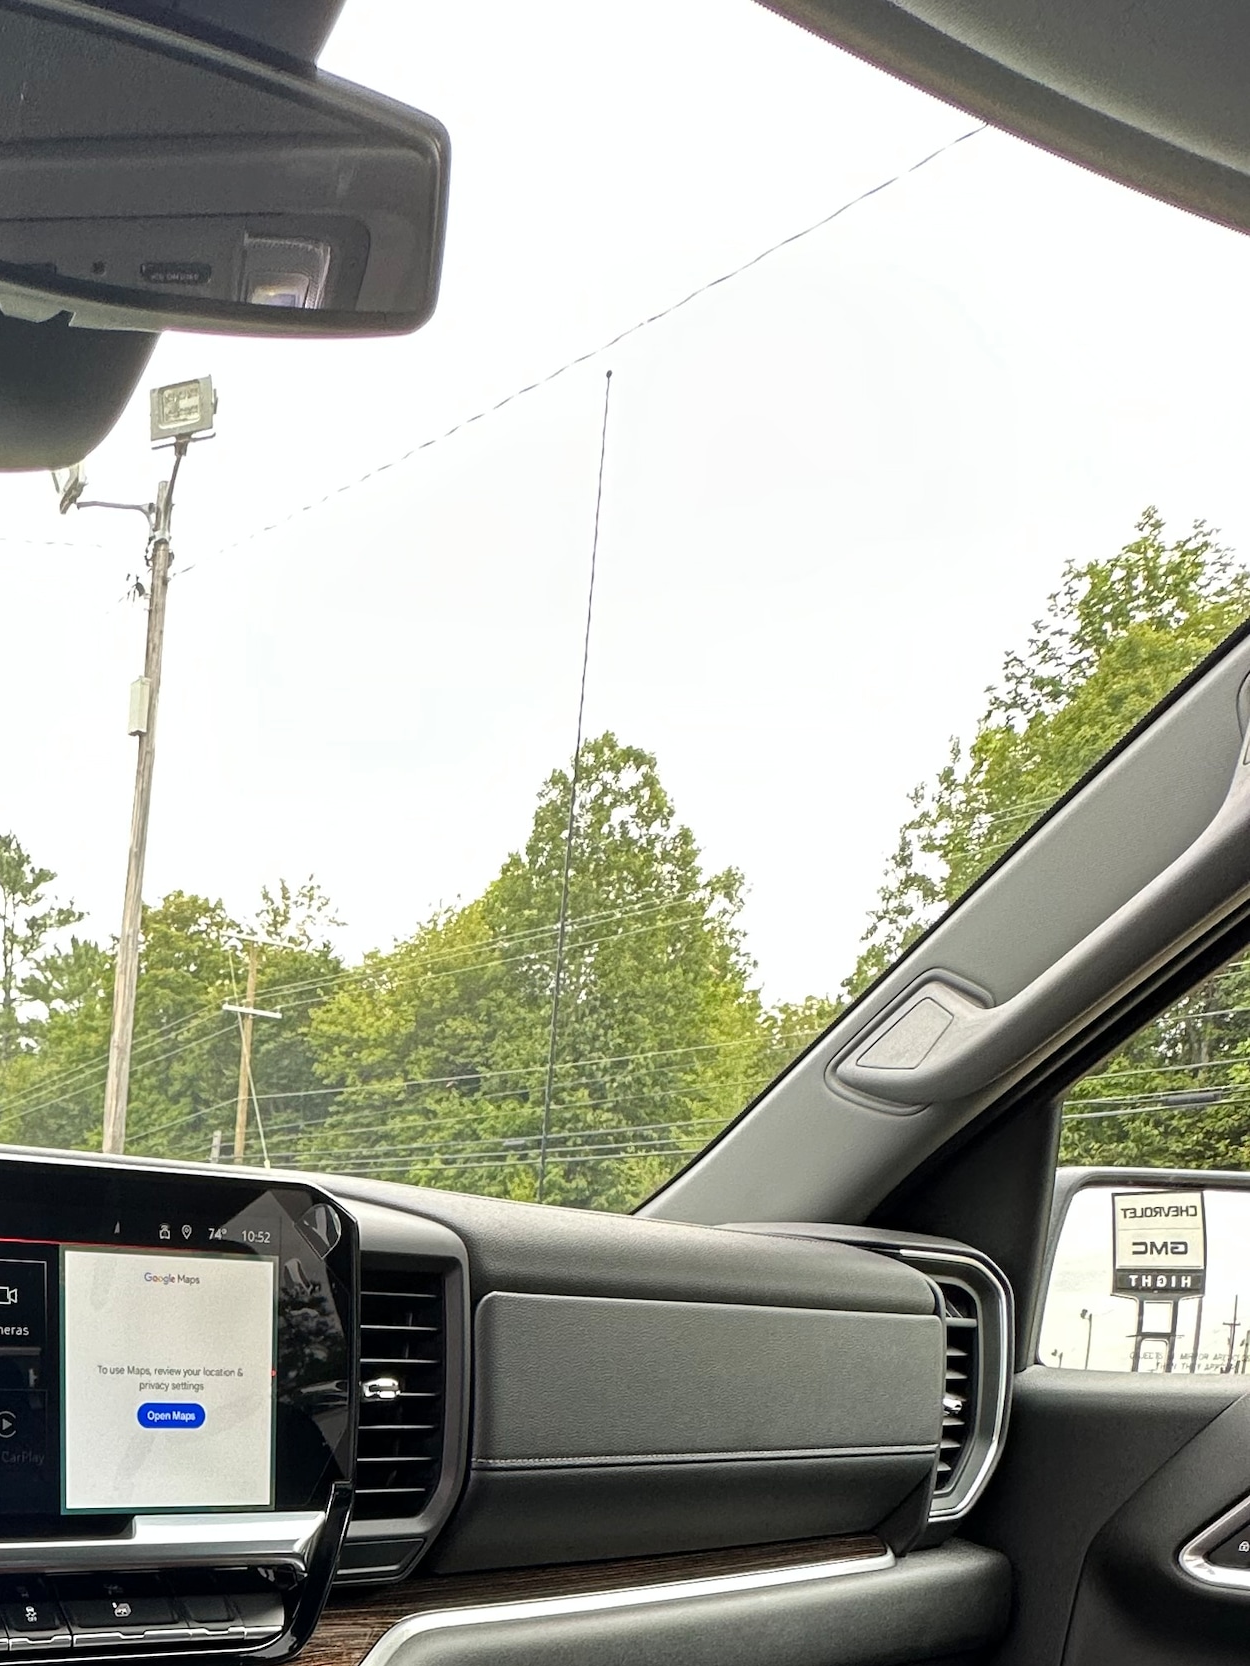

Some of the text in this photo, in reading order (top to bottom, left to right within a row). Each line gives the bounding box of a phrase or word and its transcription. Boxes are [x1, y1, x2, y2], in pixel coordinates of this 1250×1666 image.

[241, 1230, 271, 1243] 10:52
[144, 1272, 200, 1286] Google Maps
[97, 1365, 108, 1375] To
[110, 1366, 125, 1375] use
[154, 1366, 181, 1376] review
[183, 1368, 201, 1378] your
[203, 1367, 235, 1377] location
[237, 1368, 243, 1377] &
[139, 1381, 204, 1393] privacy settings
[147, 1410, 196, 1423] Open Maps
[1, 1450, 46, 1466] CarPlay
